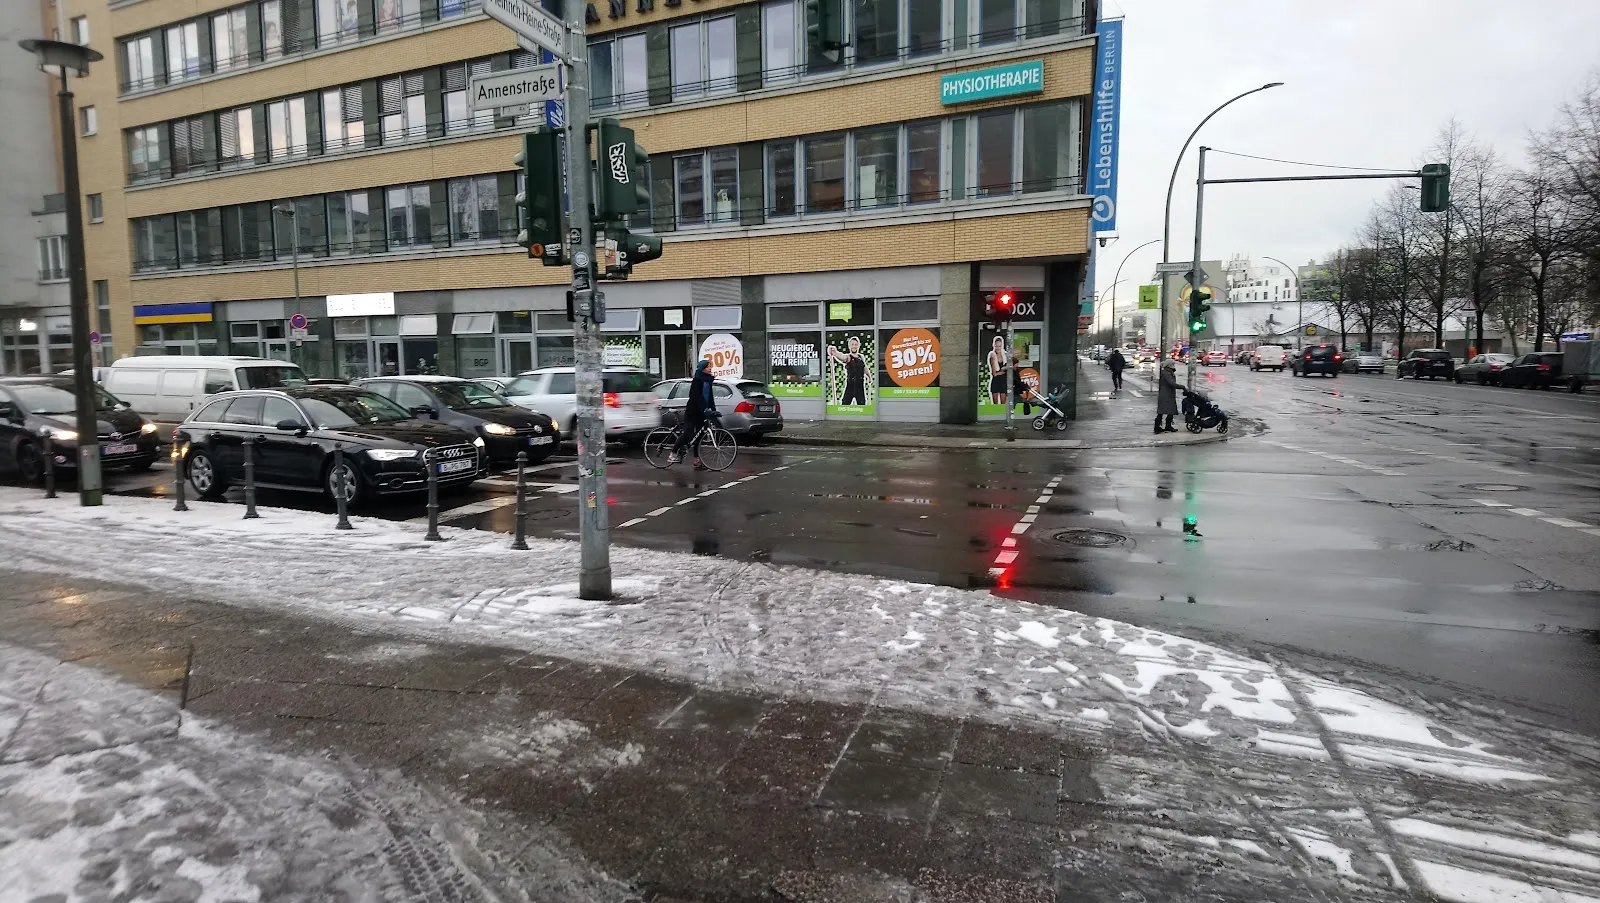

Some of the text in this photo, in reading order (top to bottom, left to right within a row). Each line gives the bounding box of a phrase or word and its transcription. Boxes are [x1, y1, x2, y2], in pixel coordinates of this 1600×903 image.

[490, 0, 562, 46] einrich-Heine-Straße
[478, 76, 555, 100] Annenstraße
[943, 68, 1040, 97] PHYSIOTHERAPIE
[1095, 30, 1115, 189] Lebenshilfe BERLIN
[771, 344, 814, 352] NEUGIERIG?
[771, 351, 818, 359] SCHAU DOCH
[474, 358, 489, 367] BGP
[788, 358, 808, 366] REIN!
[890, 344, 937, 369] 30%
[712, 366, 738, 377] paren!
[897, 364, 934, 379] sparen!
